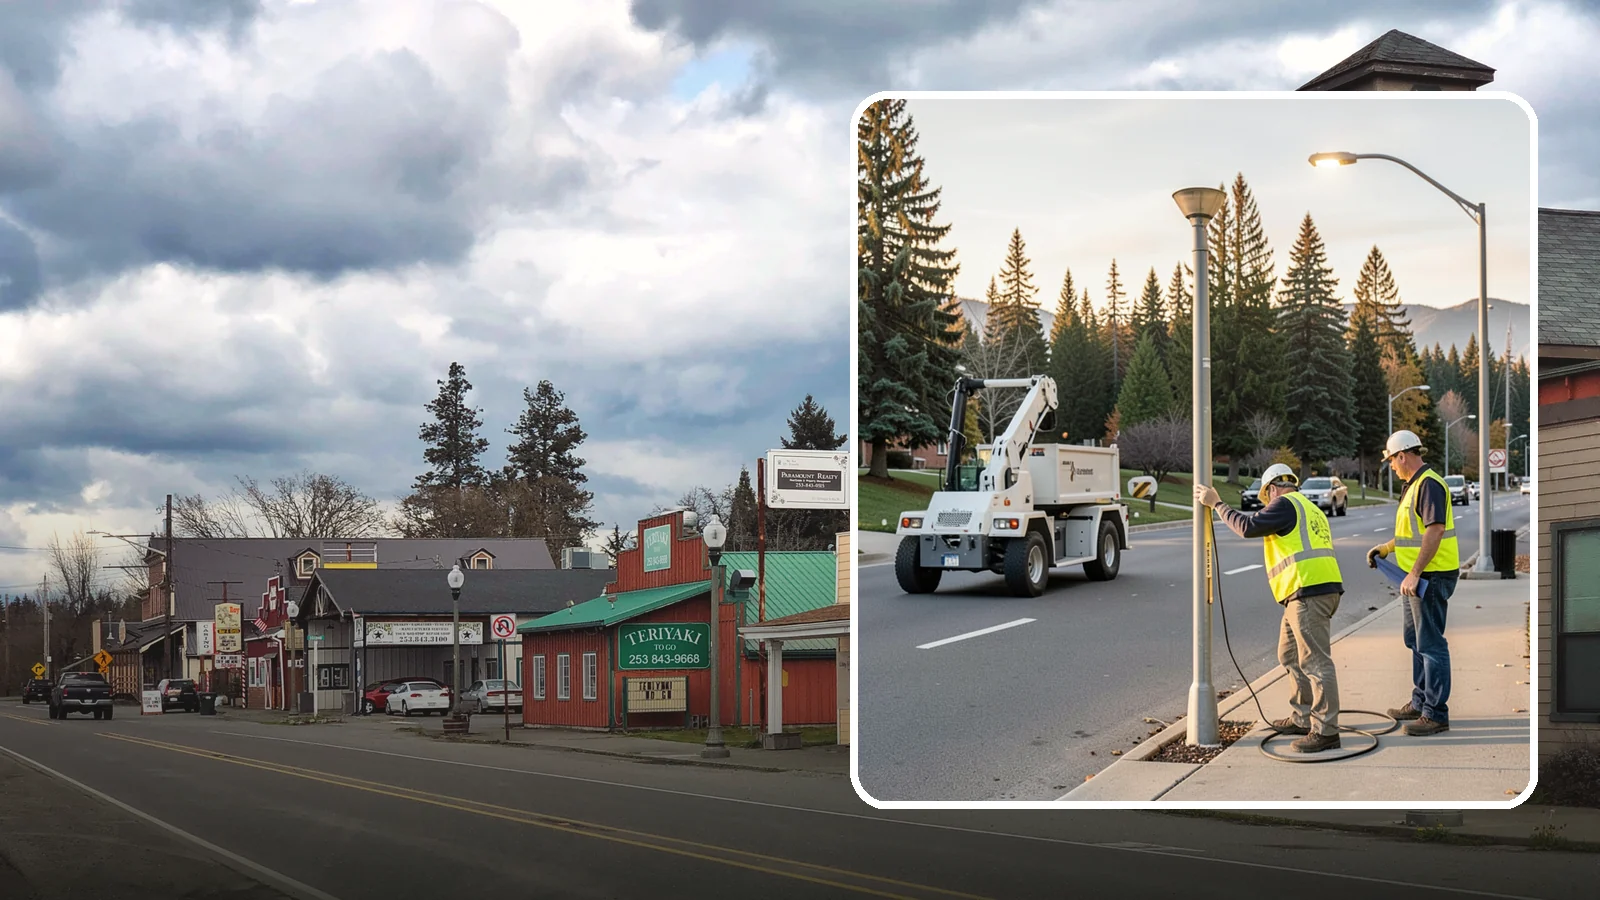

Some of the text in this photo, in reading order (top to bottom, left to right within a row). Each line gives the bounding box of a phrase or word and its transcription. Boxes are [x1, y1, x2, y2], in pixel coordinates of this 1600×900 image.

[625, 628, 702, 646] TERIYAKI
[629, 654, 700, 664] 253 843-9668
[639, 681, 672, 691] TERIYAKI
